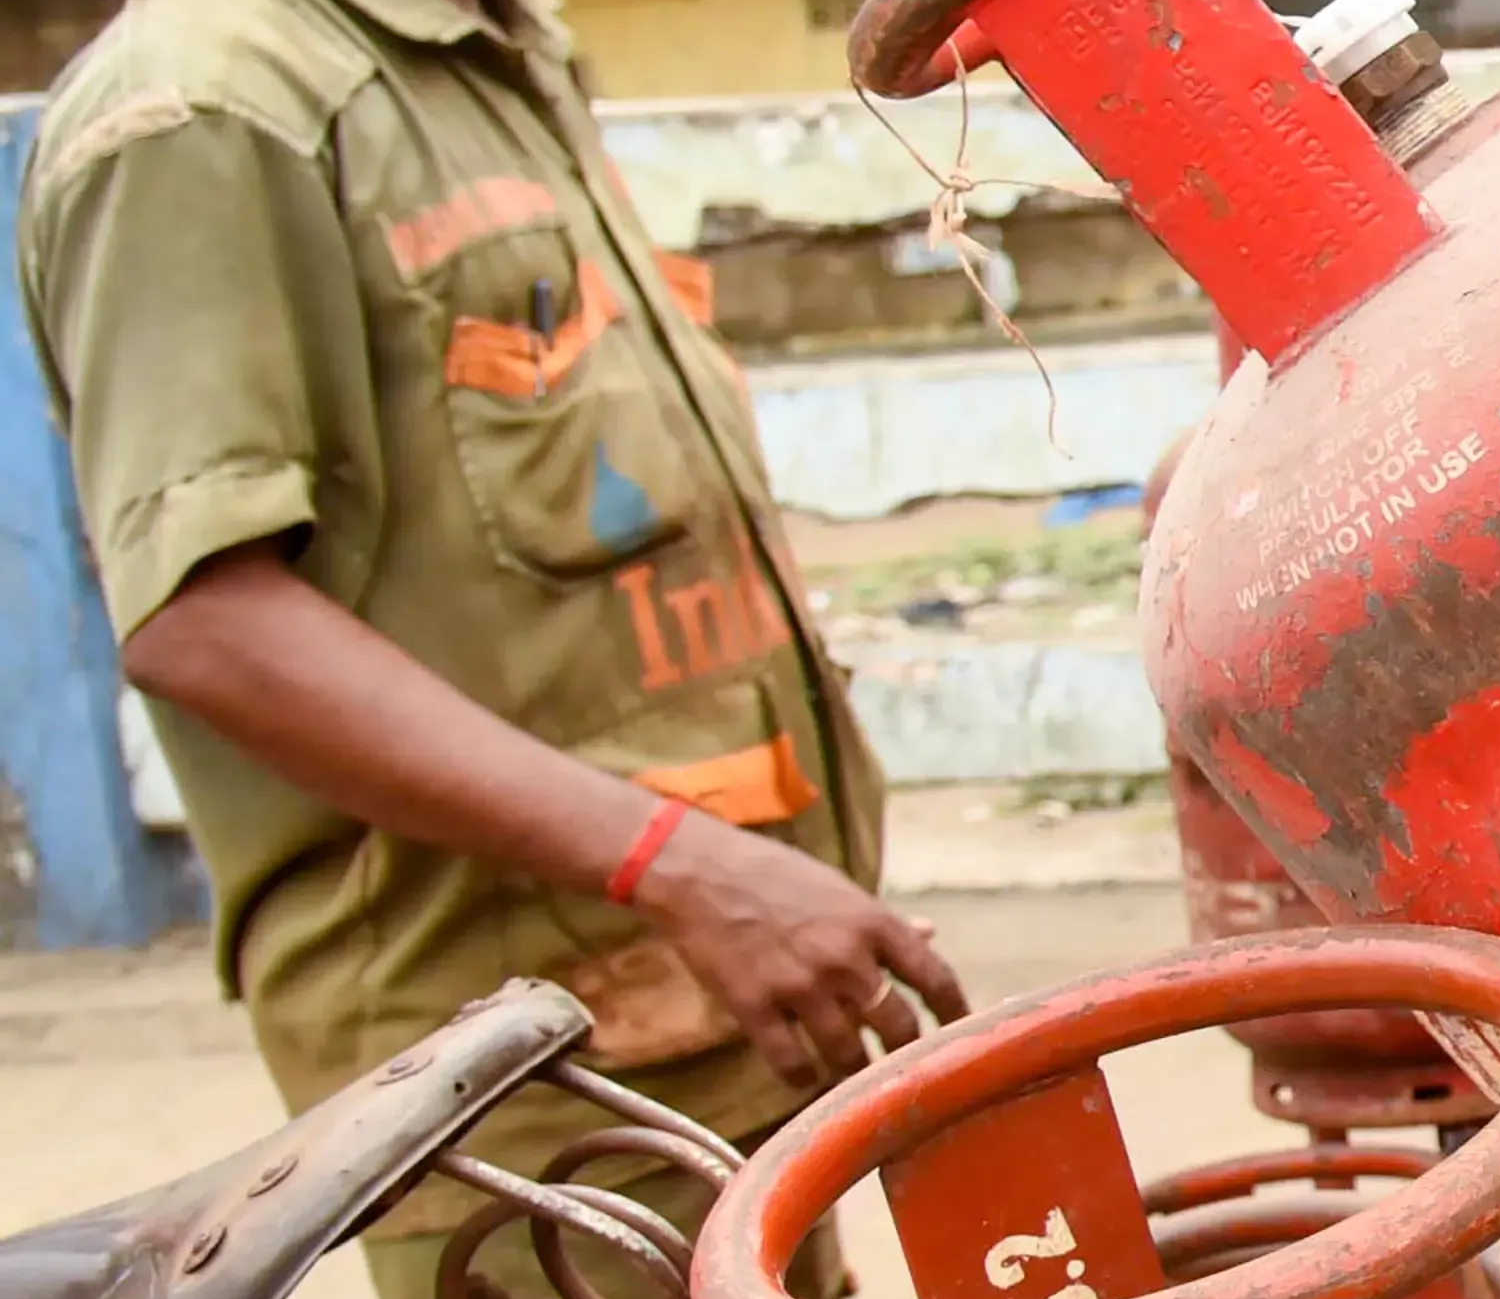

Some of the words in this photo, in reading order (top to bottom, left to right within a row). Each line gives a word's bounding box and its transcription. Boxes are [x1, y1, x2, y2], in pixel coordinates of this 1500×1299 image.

[1362, 411, 1420, 468] OFF
[1379, 484, 1418, 525] IN
[1419, 432, 1488, 497] USE
